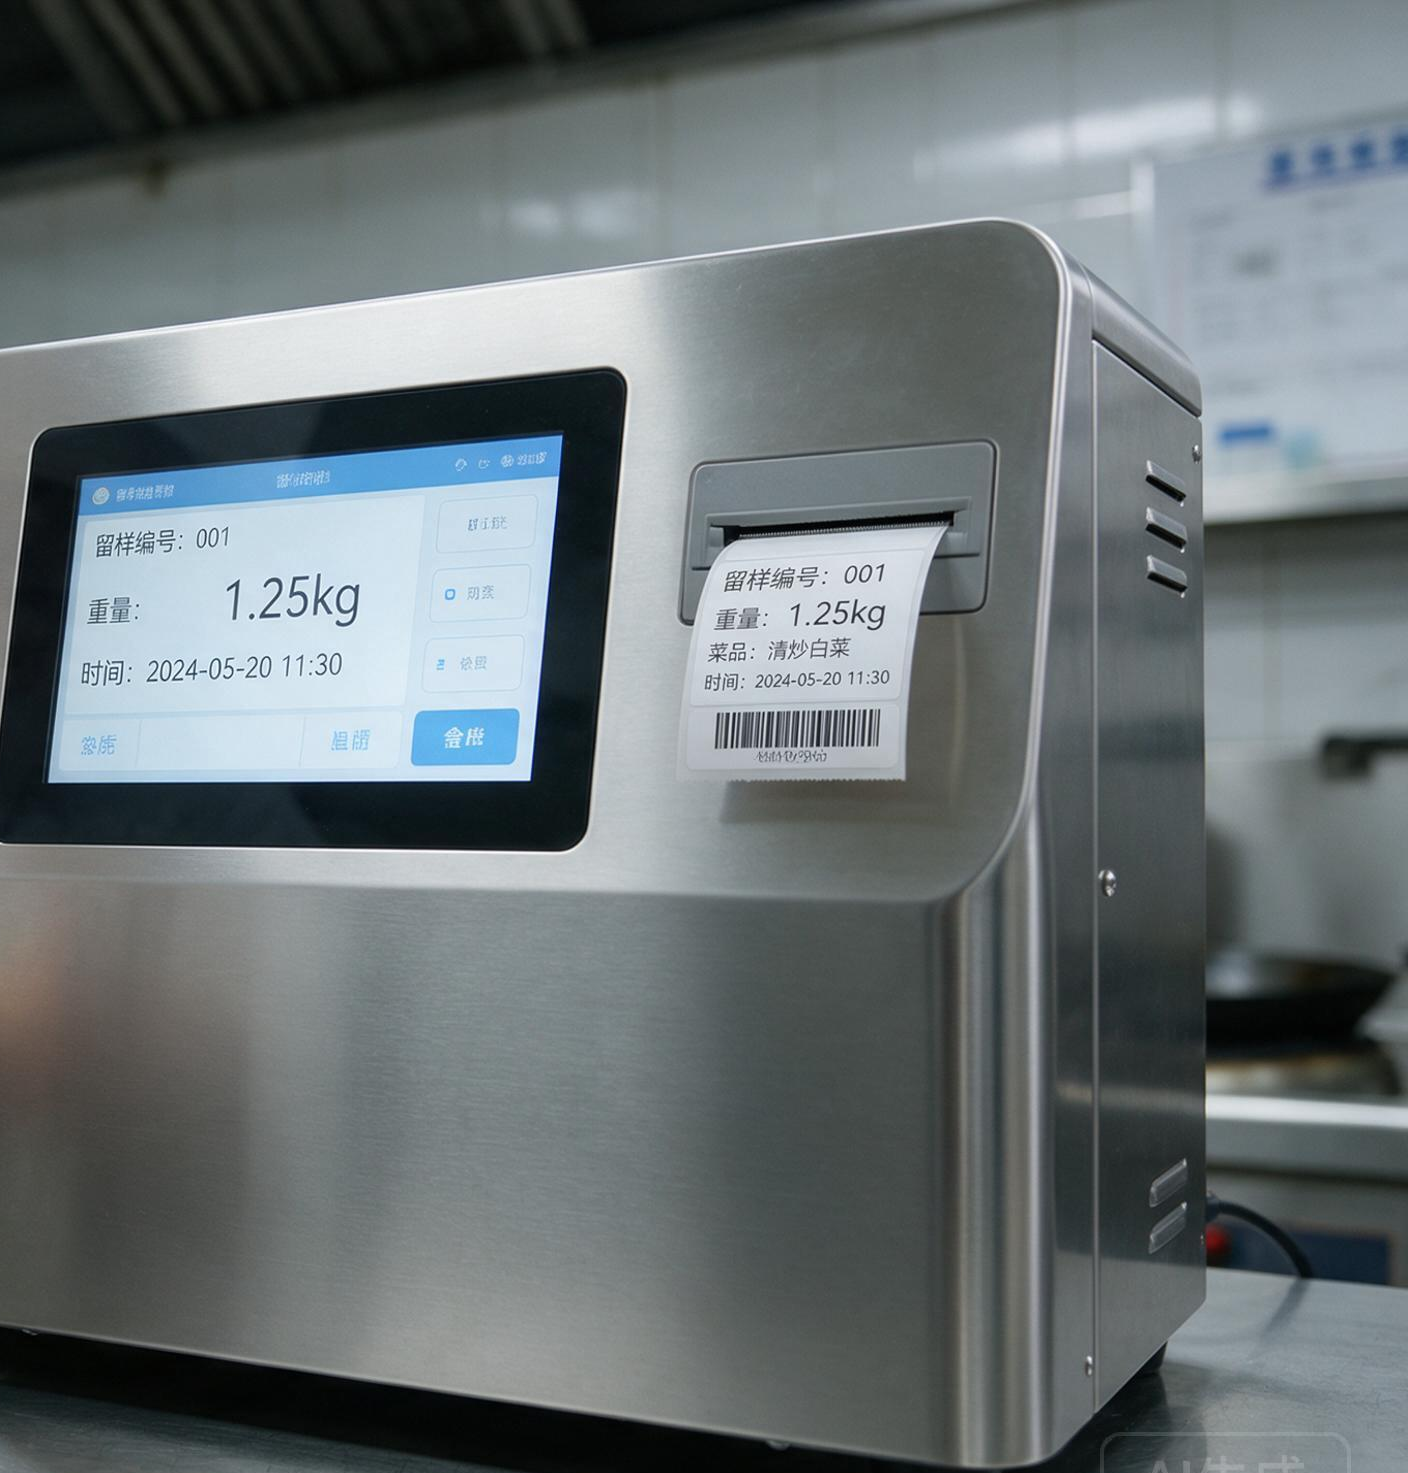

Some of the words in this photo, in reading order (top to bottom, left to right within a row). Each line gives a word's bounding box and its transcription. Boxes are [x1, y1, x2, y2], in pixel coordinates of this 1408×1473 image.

[196, 526, 230, 549] 001
[843, 563, 886, 585] 001
[225, 572, 361, 628] 1.25kg
[789, 598, 887, 631] 1.25kg
[146, 656, 273, 683] 2024-05-20
[282, 652, 343, 678] 11:30
[754, 671, 842, 689] 2024-05-20
[848, 669, 890, 686] 11:30
